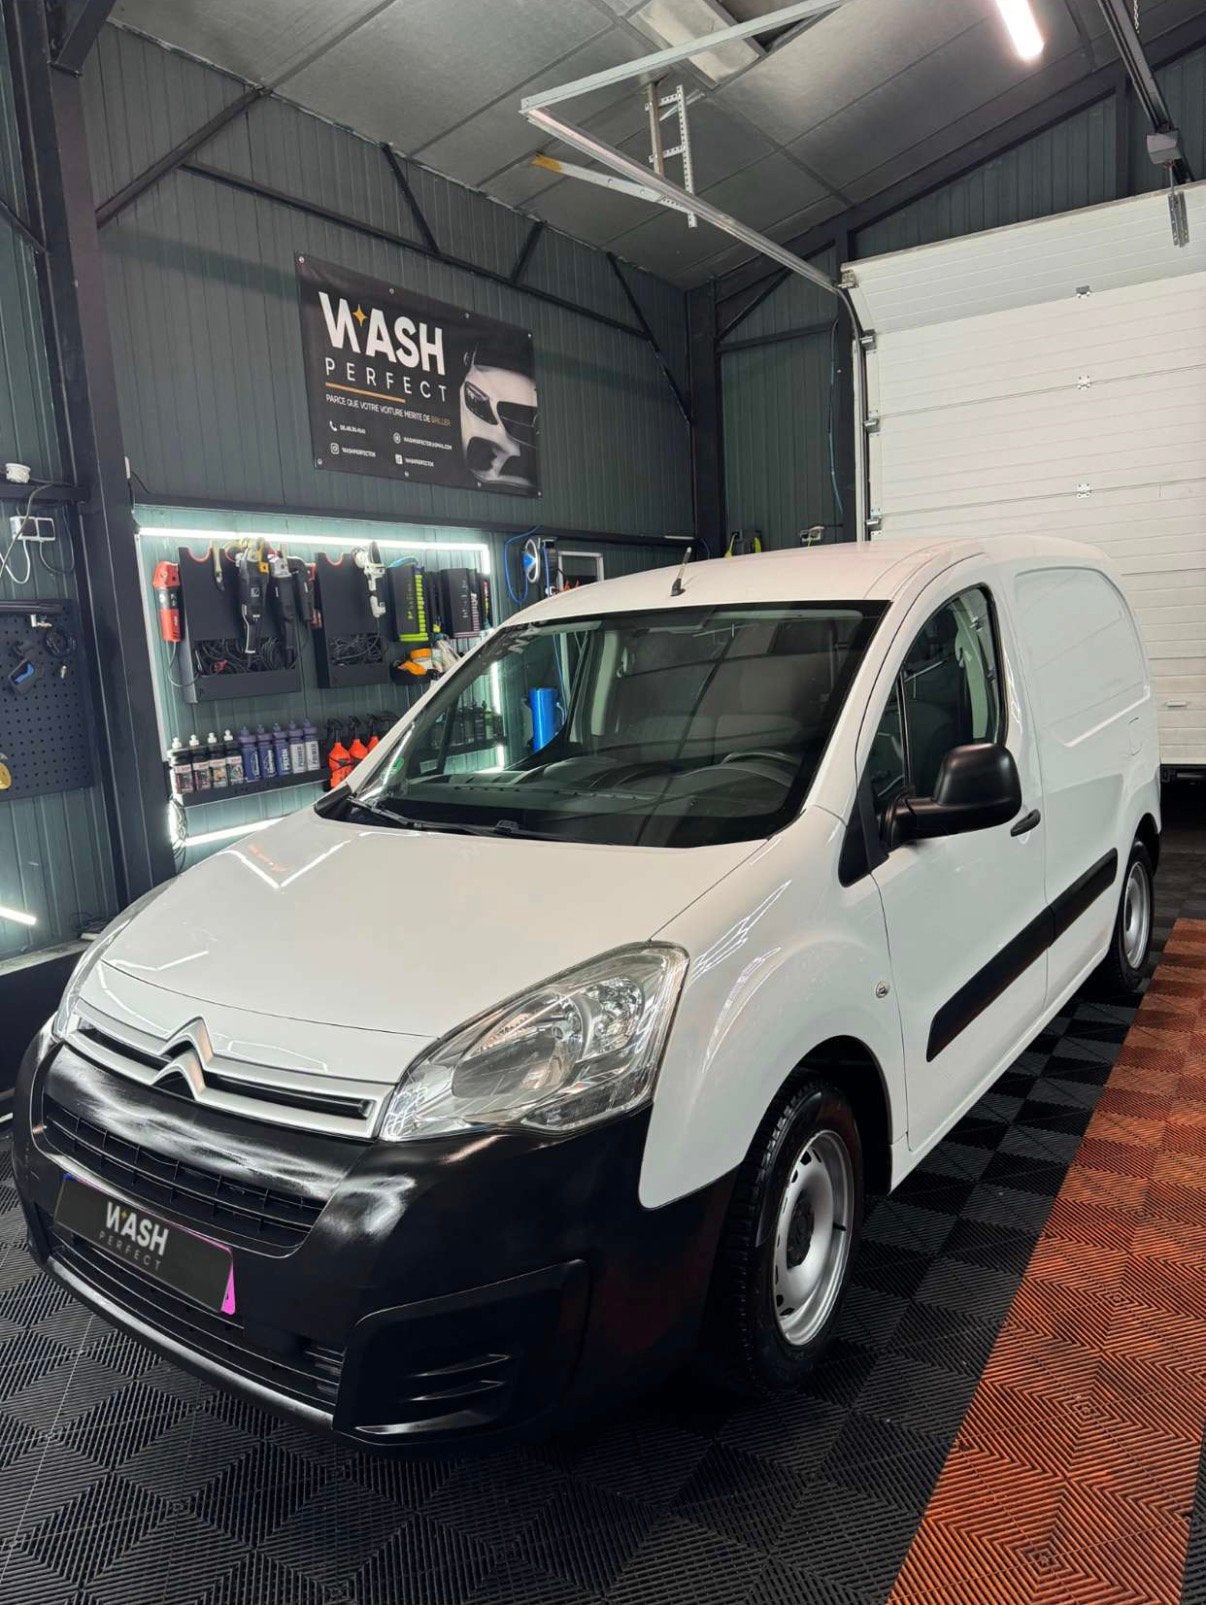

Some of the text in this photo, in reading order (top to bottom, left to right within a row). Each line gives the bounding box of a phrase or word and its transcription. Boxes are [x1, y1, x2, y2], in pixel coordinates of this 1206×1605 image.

[318, 291, 446, 376] WASH
[324, 356, 448, 403] PERFECT
[325, 393, 346, 406] PARCE
[347, 398, 359, 408] QUE
[360, 401, 379, 413] VOTRE
[380, 405, 403, 418] VOITURE
[423, 413, 431, 422] DE
[99, 1231, 162, 1271] PERFECT
[106, 1201, 169, 1256] WASH
